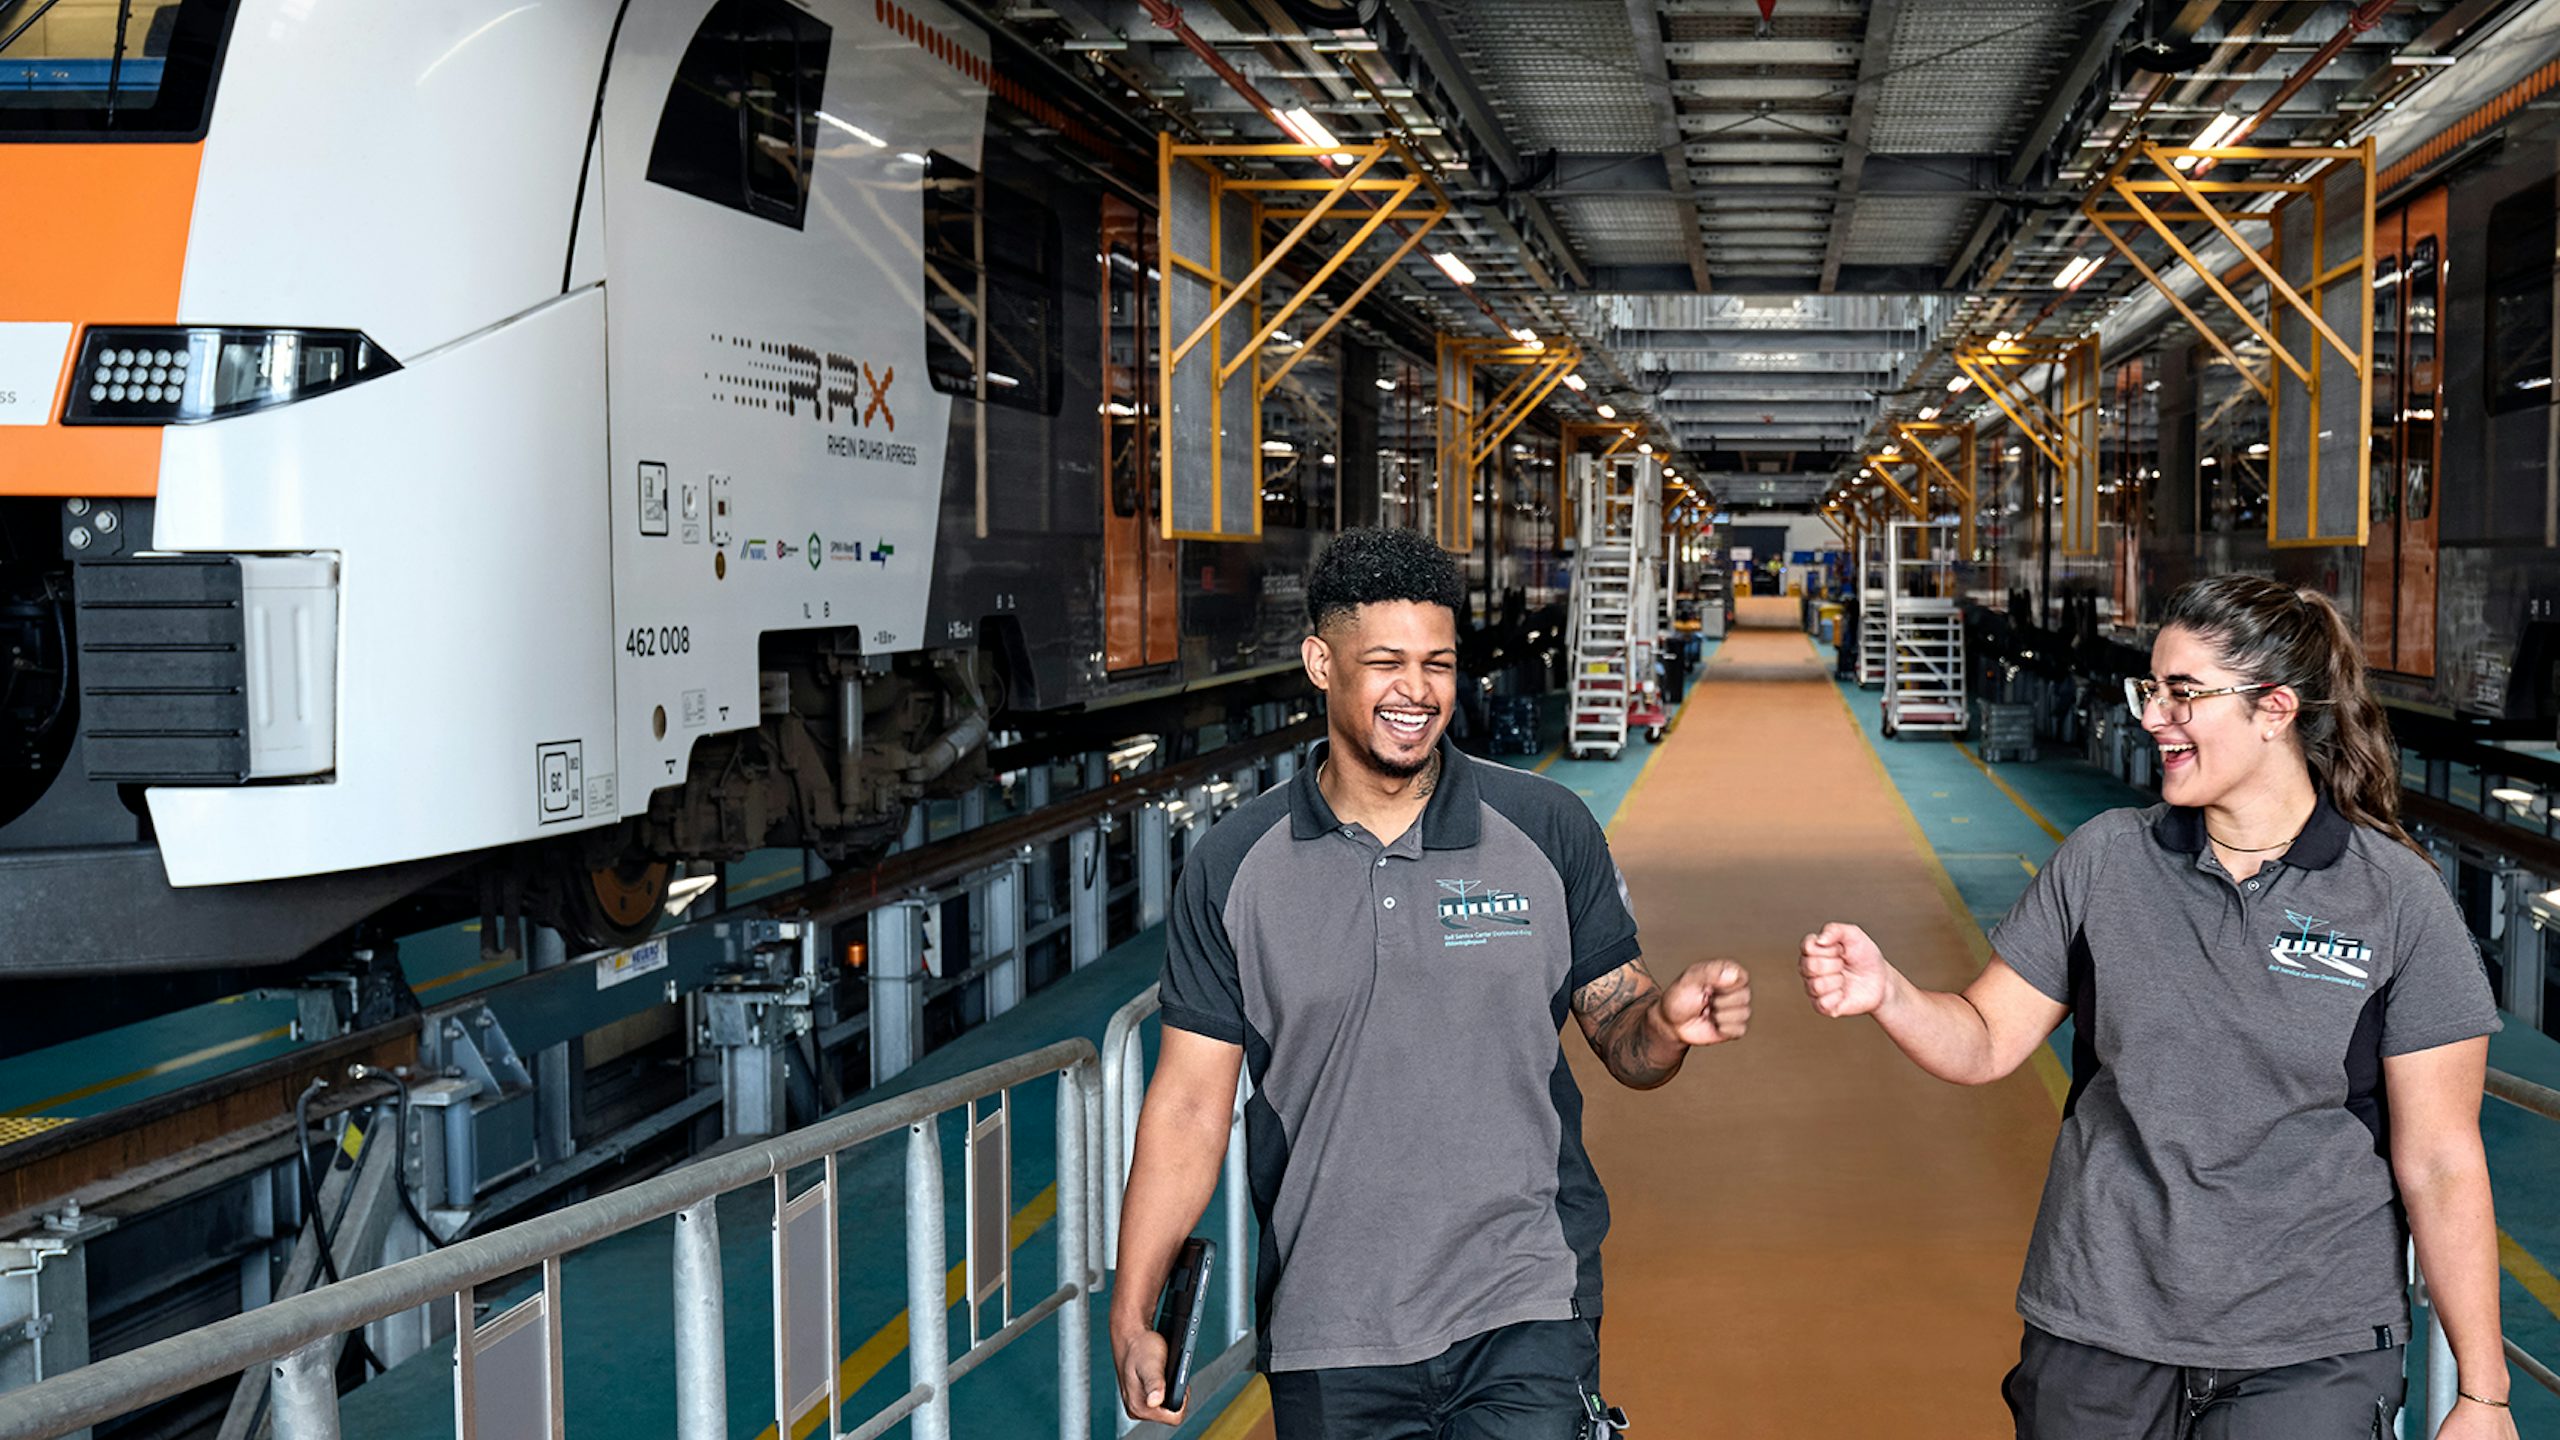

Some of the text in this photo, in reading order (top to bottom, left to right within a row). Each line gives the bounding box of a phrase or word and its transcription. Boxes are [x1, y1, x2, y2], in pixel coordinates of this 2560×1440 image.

[828, 434, 918, 466] RHEIN RUHR XPRESS
[626, 625, 691, 657] 462 008
